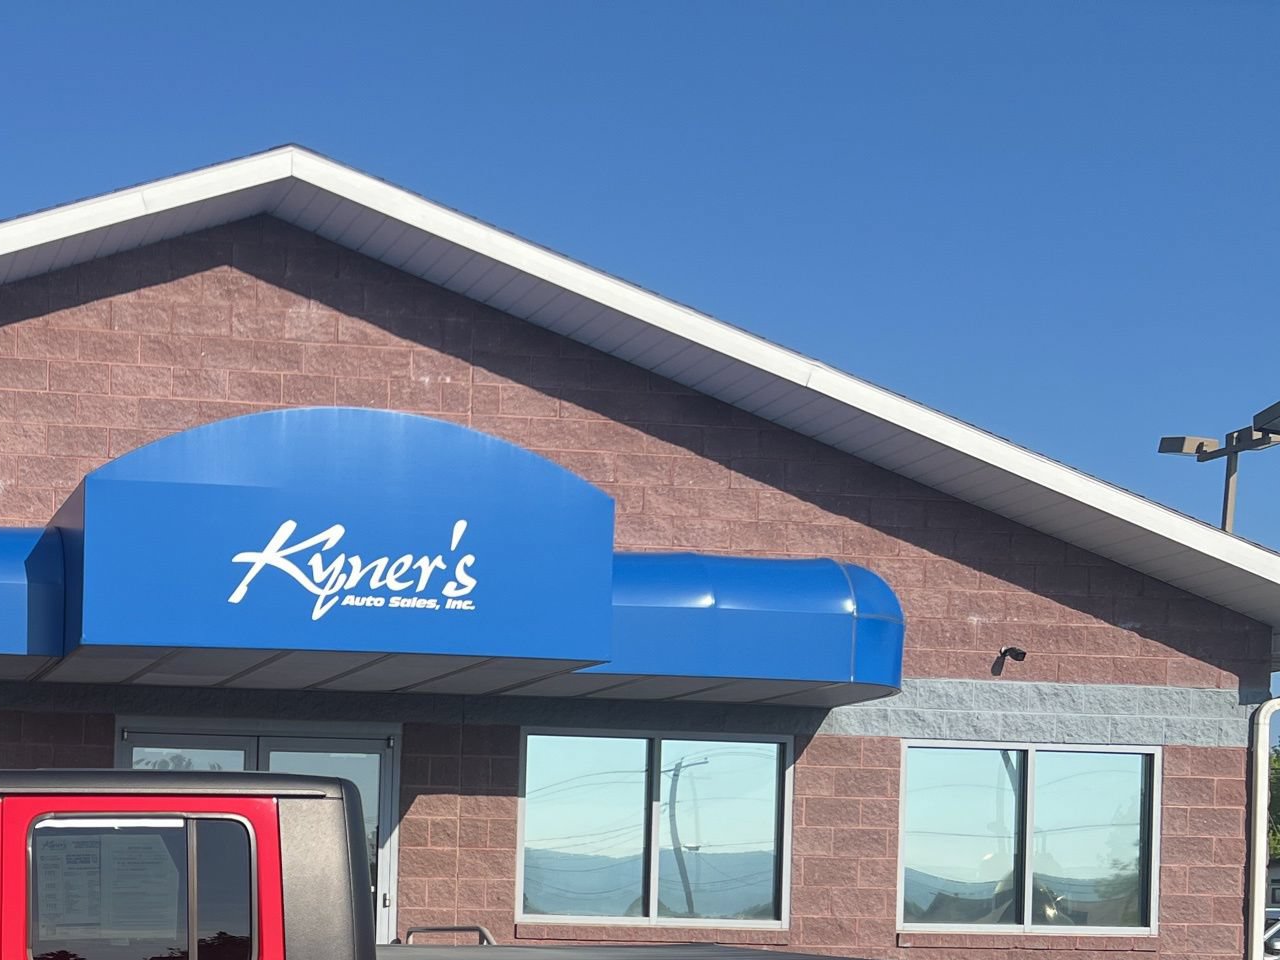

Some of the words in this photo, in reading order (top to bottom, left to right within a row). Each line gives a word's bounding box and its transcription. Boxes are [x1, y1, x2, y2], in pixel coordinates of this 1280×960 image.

[227, 519, 478, 621] Kyner's
[340, 594, 386, 608] Auto
[387, 596, 441, 611] Sales,
[444, 597, 476, 611] Inc.
